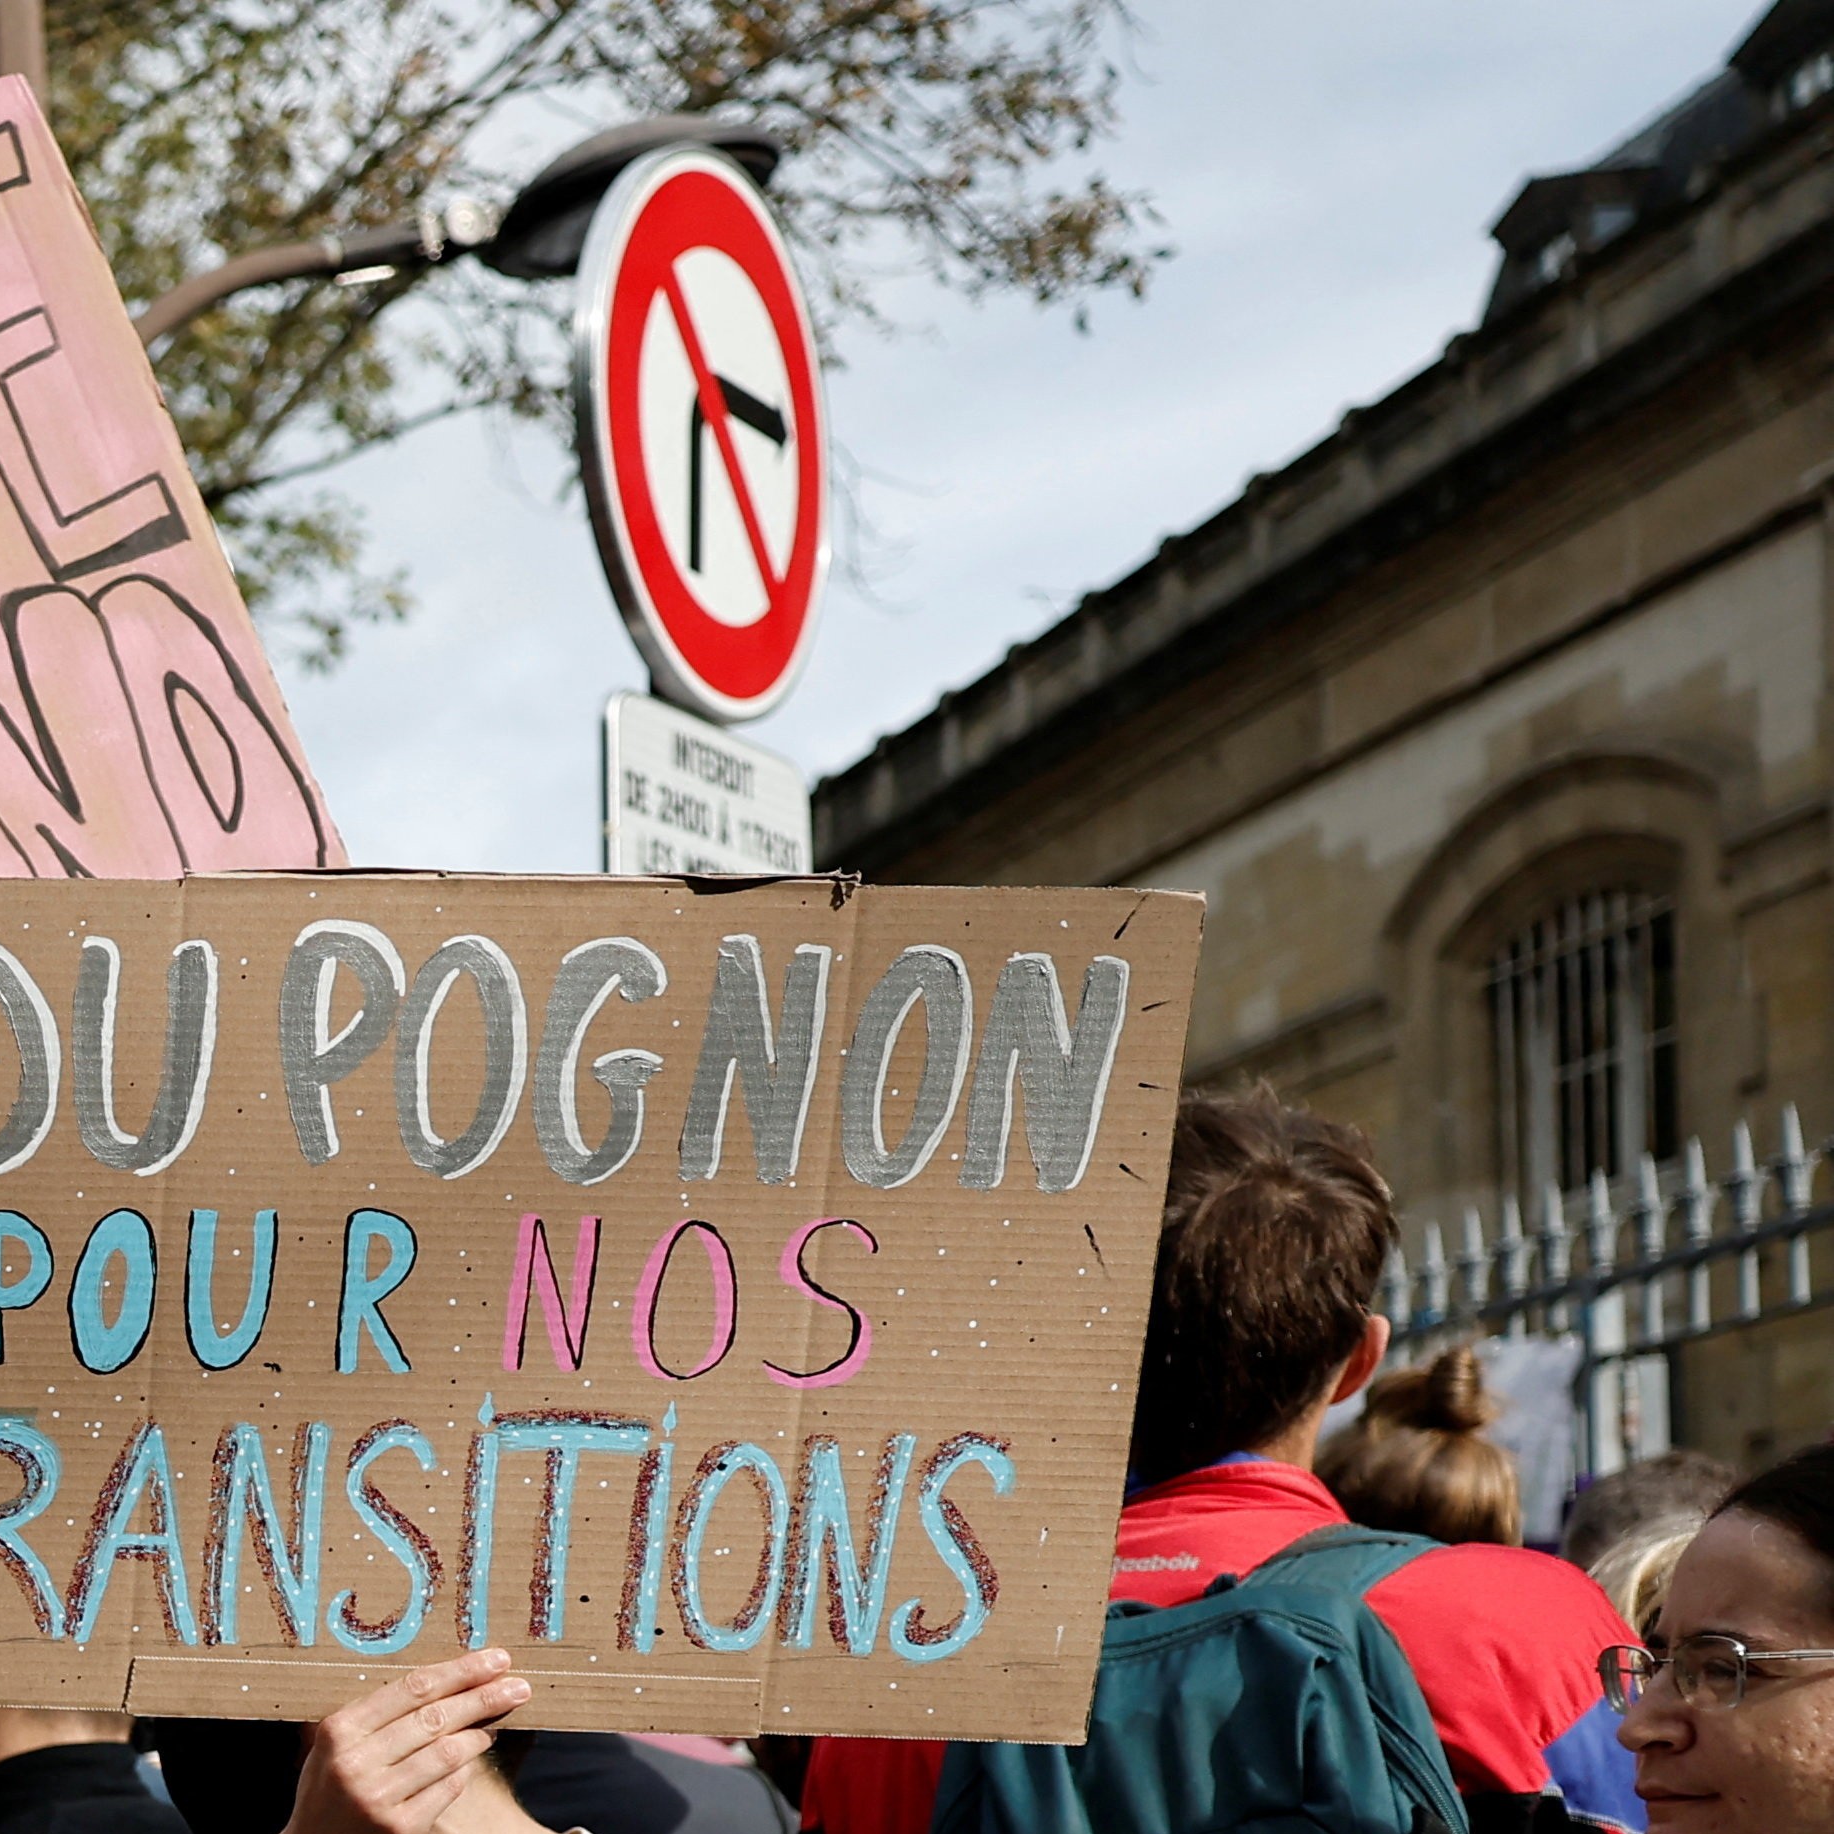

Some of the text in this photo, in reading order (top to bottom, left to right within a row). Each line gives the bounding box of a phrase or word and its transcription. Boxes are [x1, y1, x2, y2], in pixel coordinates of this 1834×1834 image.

[674, 731, 755, 798] INTERDIT
[279, 920, 1130, 1191] POGNON
[499, 1213, 880, 1389] NOS
